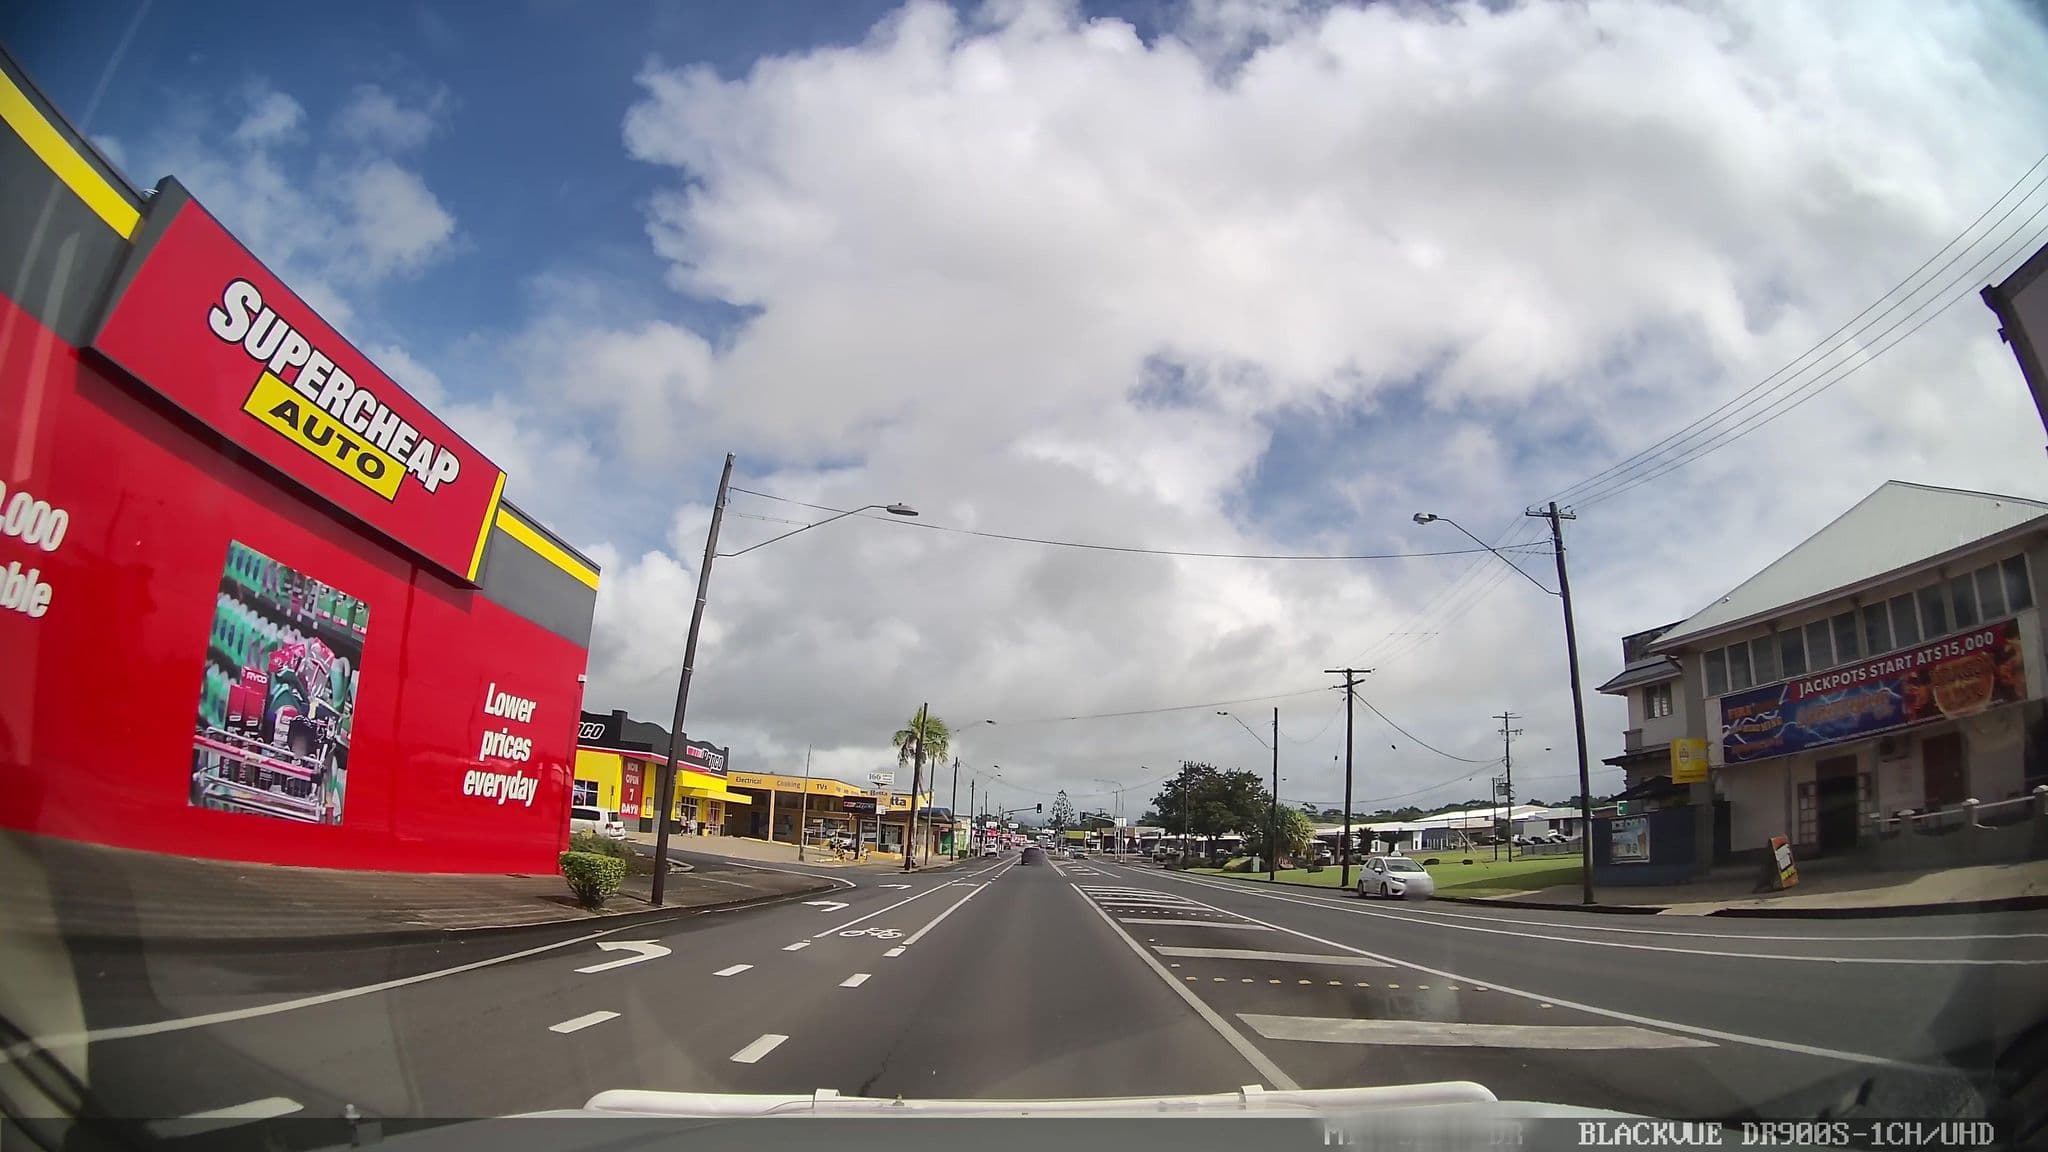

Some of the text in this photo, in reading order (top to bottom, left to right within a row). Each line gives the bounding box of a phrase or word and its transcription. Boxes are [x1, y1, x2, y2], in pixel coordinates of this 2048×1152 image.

[207, 277, 461, 495] SUPERCHEAP
[269, 399, 386, 480] AUTO
[1800, 667, 1867, 699] JACKPOTS
[1870, 655, 1912, 678] START
[484, 682, 537, 723] Lower
[479, 727, 532, 761] prices
[463, 767, 539, 807] everyday
[625, 774, 639, 785] OPEN
[629, 788, 634, 801] 7
[735, 776, 762, 785] Electrical
